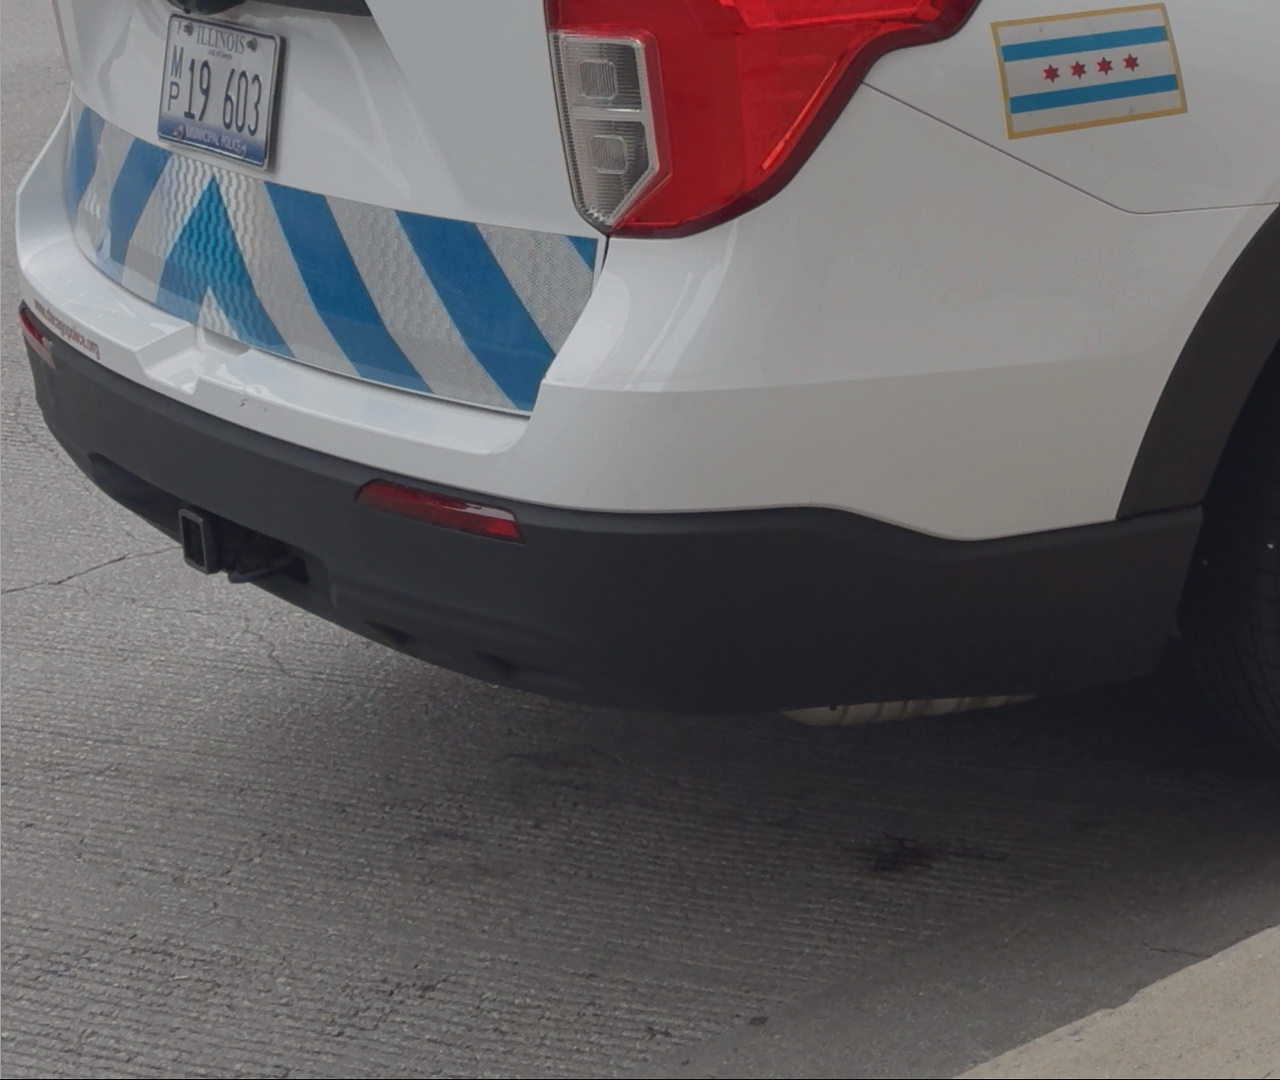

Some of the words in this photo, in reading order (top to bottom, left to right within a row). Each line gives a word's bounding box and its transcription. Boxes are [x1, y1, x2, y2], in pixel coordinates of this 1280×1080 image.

[196, 27, 245, 55] ILLINOIS
[183, 58, 211, 122] 19
[222, 68, 262, 137] 603
